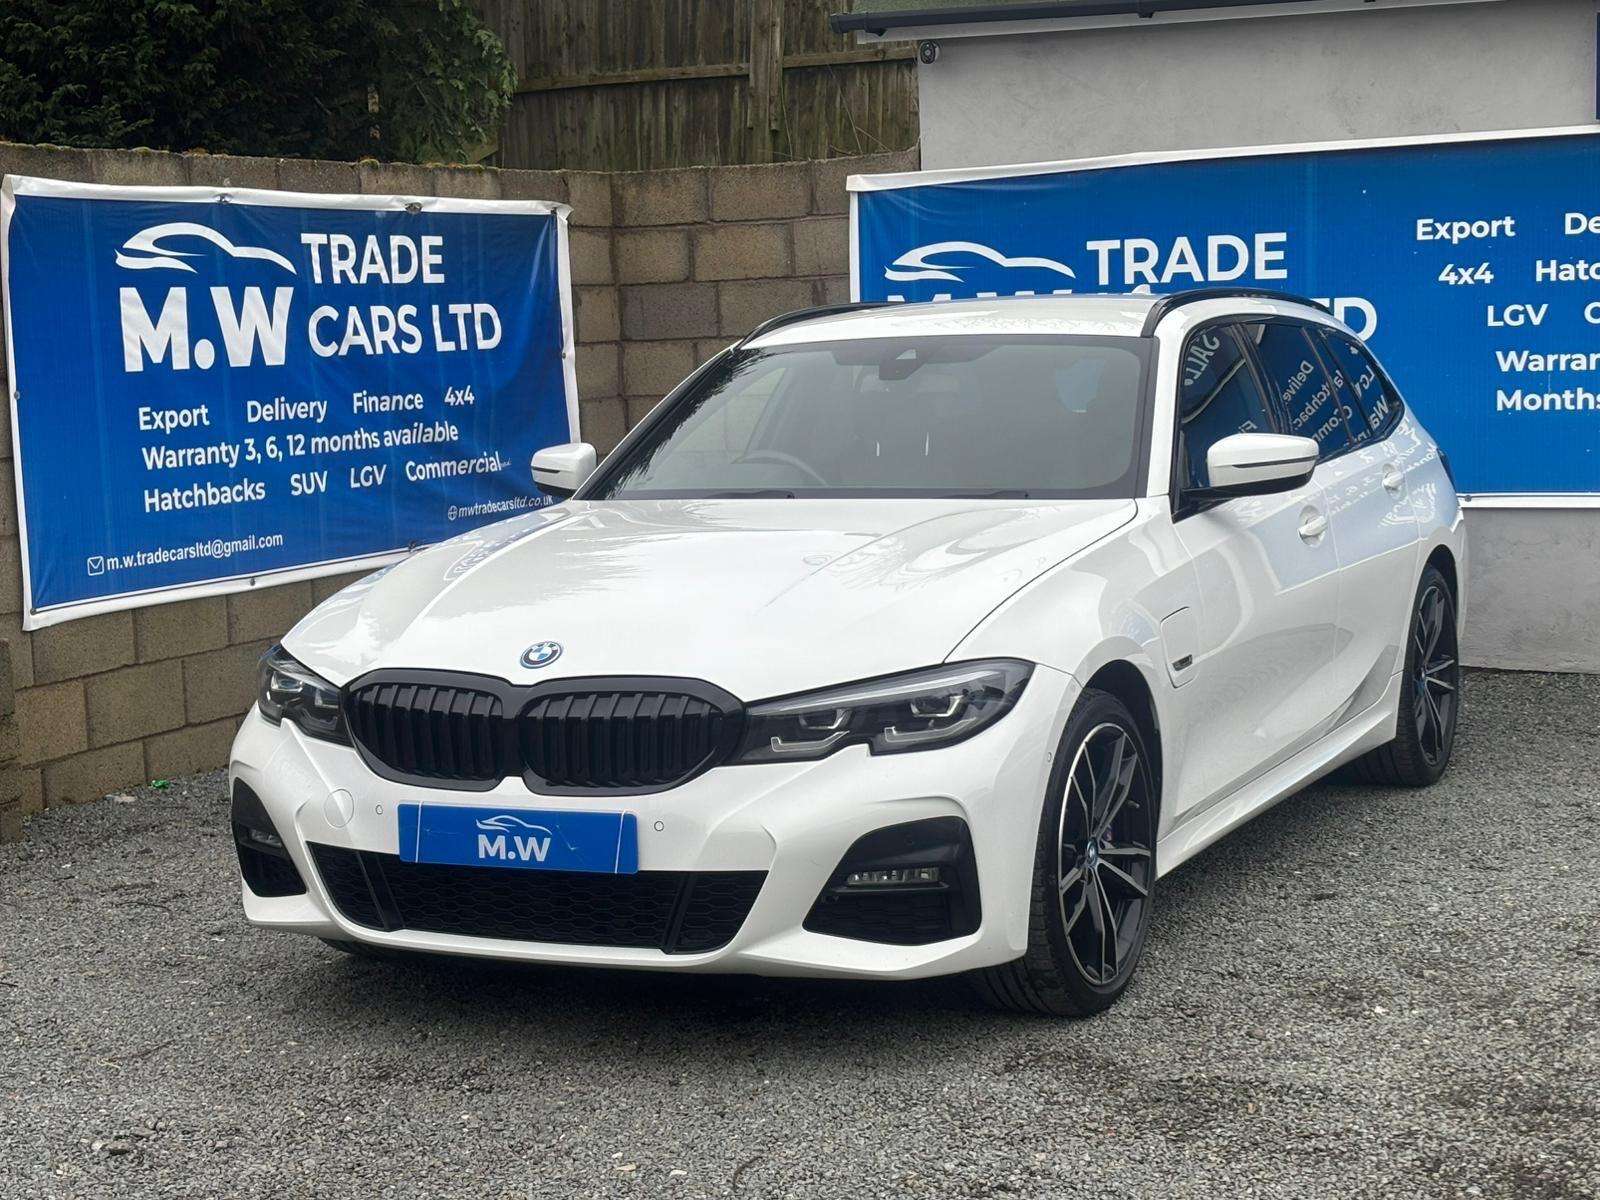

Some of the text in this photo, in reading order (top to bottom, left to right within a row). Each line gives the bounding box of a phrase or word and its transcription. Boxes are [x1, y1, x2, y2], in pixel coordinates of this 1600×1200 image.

[1416, 216, 1516, 244] Export
[300, 232, 445, 285] TRADE
[1086, 231, 1288, 285] TRADE
[1438, 262, 1494, 285] 4x4
[120, 285, 295, 373] M.W
[307, 303, 502, 358] CARS LTD
[1487, 304, 1549, 327] LGV
[138, 385, 476, 431] Export Delivery Finance 4x4
[1496, 387, 1600, 411] Month
[142, 422, 459, 471] Warranty 3, 6, 12 months available
[144, 450, 502, 513] Hatchbacks SUV LGV Commercial
[458, 495, 554, 518] mwtradecarsltd.co.uk
[107, 534, 284, 571] m.w.tradecarsltd@gmail.com
[478, 833, 551, 862] M.W
